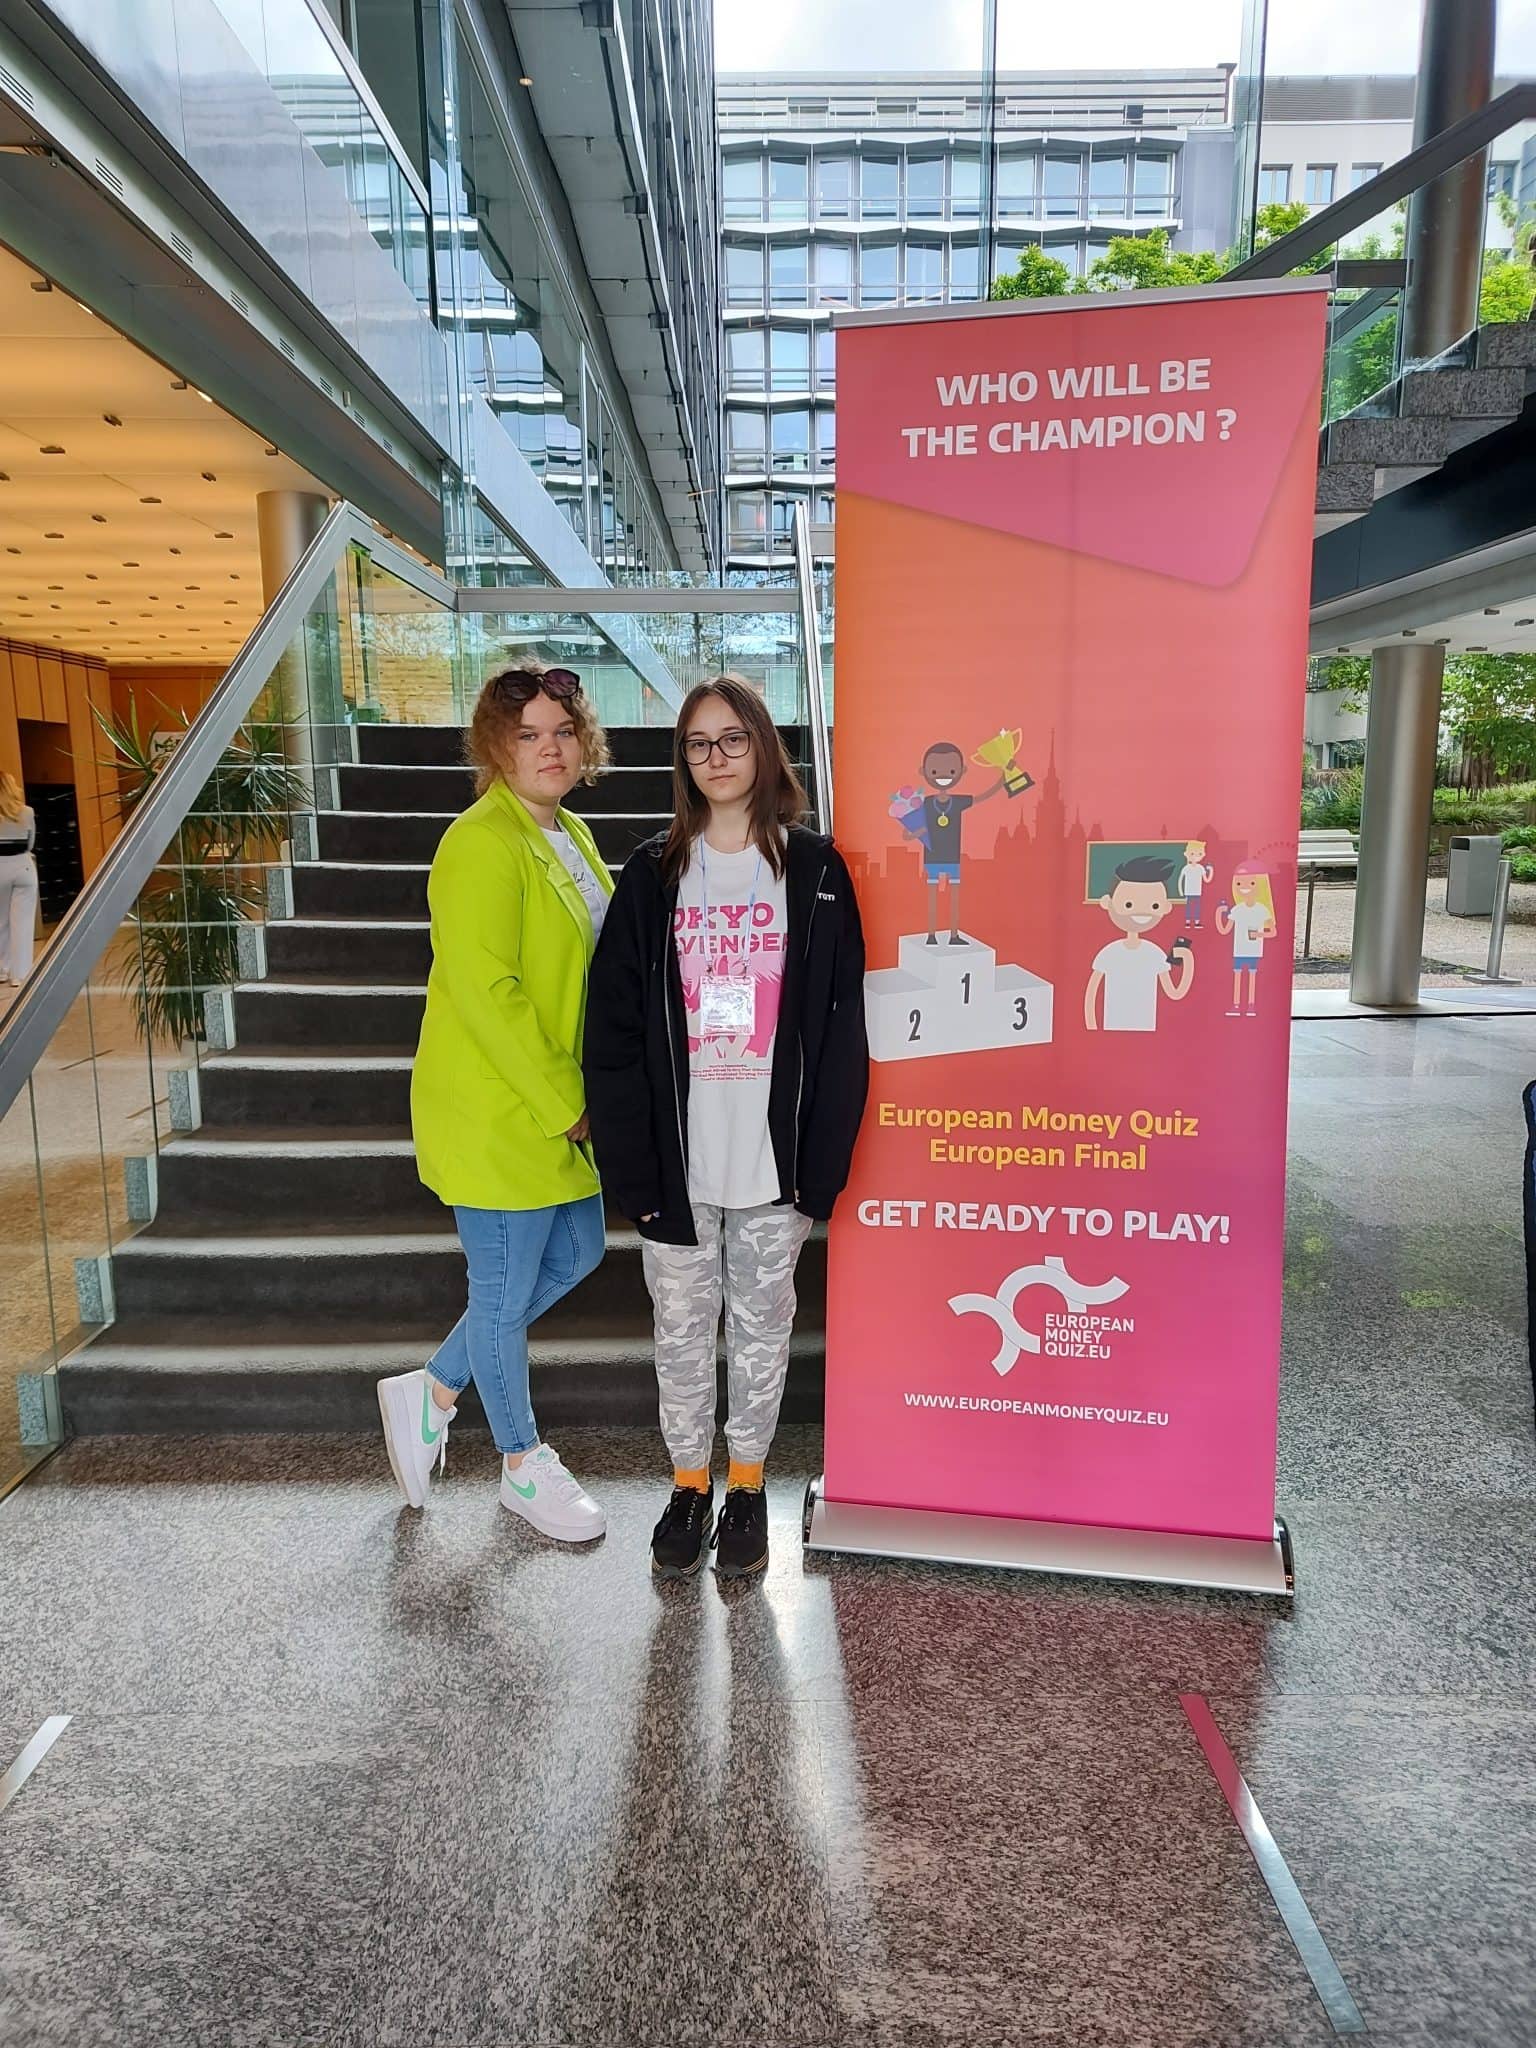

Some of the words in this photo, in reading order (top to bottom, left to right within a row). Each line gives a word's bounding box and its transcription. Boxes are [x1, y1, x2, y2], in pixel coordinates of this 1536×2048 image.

[936, 370, 1038, 407] WHO
[1047, 363, 1150, 400] WILL
[1159, 358, 1211, 393] BE
[901, 424, 978, 458] THE
[988, 410, 1205, 453] CHAMPION
[1216, 408, 1237, 441] ?
[961, 972, 971, 1005] 1
[907, 1009, 921, 1042] 2
[1012, 997, 1028, 1031] 3
[879, 1103, 1013, 1133] European
[1022, 1106, 1122, 1139] Money
[1129, 1110, 1199, 1139] Quiz
[930, 1139, 1065, 1170] European
[1074, 1143, 1146, 1170] Final
[857, 1200, 927, 1227] GET
[934, 1202, 1056, 1233] READY
[1061, 1207, 1113, 1237] TO
[1124, 1210, 1230, 1244] PLAY!
[1045, 1313, 1135, 1333] EUROPEAN
[1045, 1329, 1103, 1345] MONEY
[1045, 1341, 1111, 1359] QUIZ.EU
[904, 1393, 1169, 1425] WWW.EUROPEANMONEYQUIZ.EU
